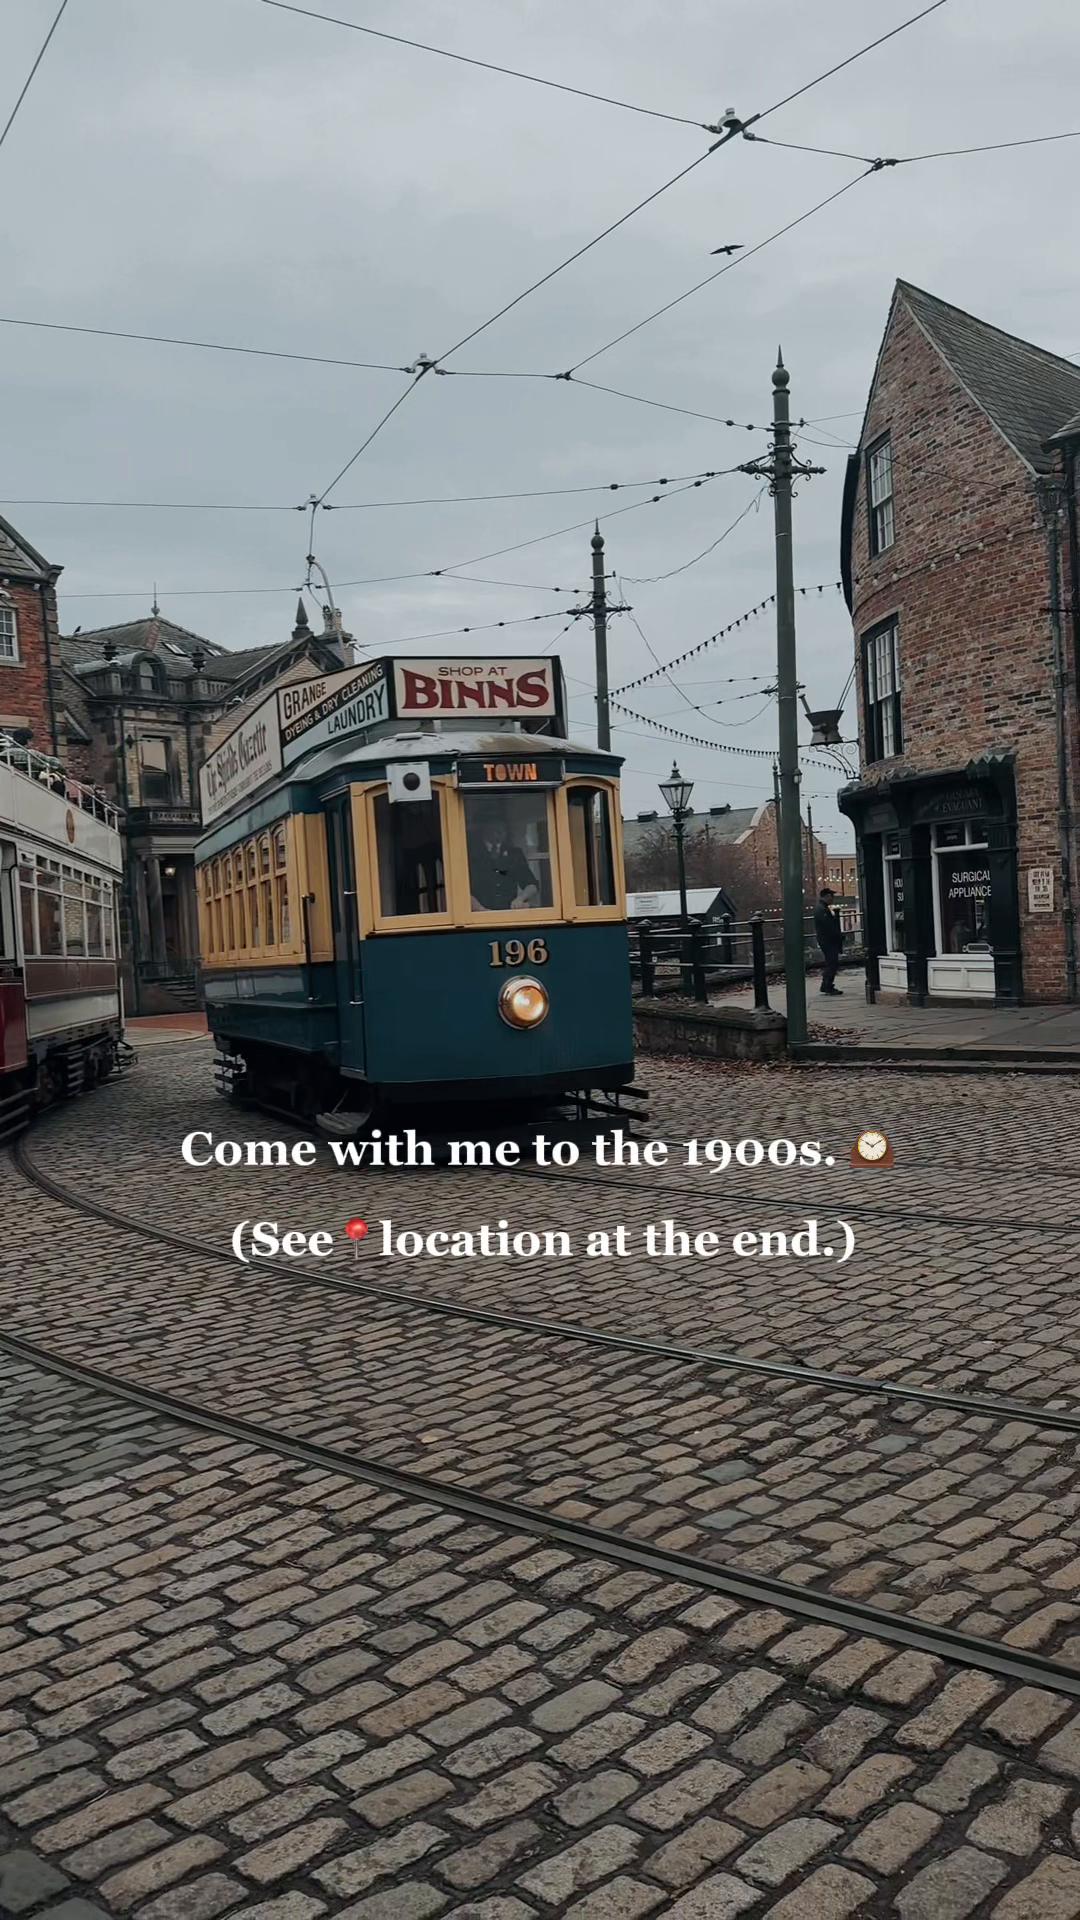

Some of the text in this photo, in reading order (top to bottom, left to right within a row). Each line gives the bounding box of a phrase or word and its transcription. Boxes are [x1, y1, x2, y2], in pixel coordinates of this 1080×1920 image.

[400, 667, 550, 710] BINNS
[438, 666, 508, 676] SHOP AT
[283, 681, 327, 720] GRANGE
[284, 713, 314, 741] DYEING
[321, 693, 340, 715] DRY
[341, 664, 383, 701] CLEANING
[327, 683, 385, 734] LAUNDRY
[483, 763, 538, 782] TOWN
[487, 938, 549, 968] 196
